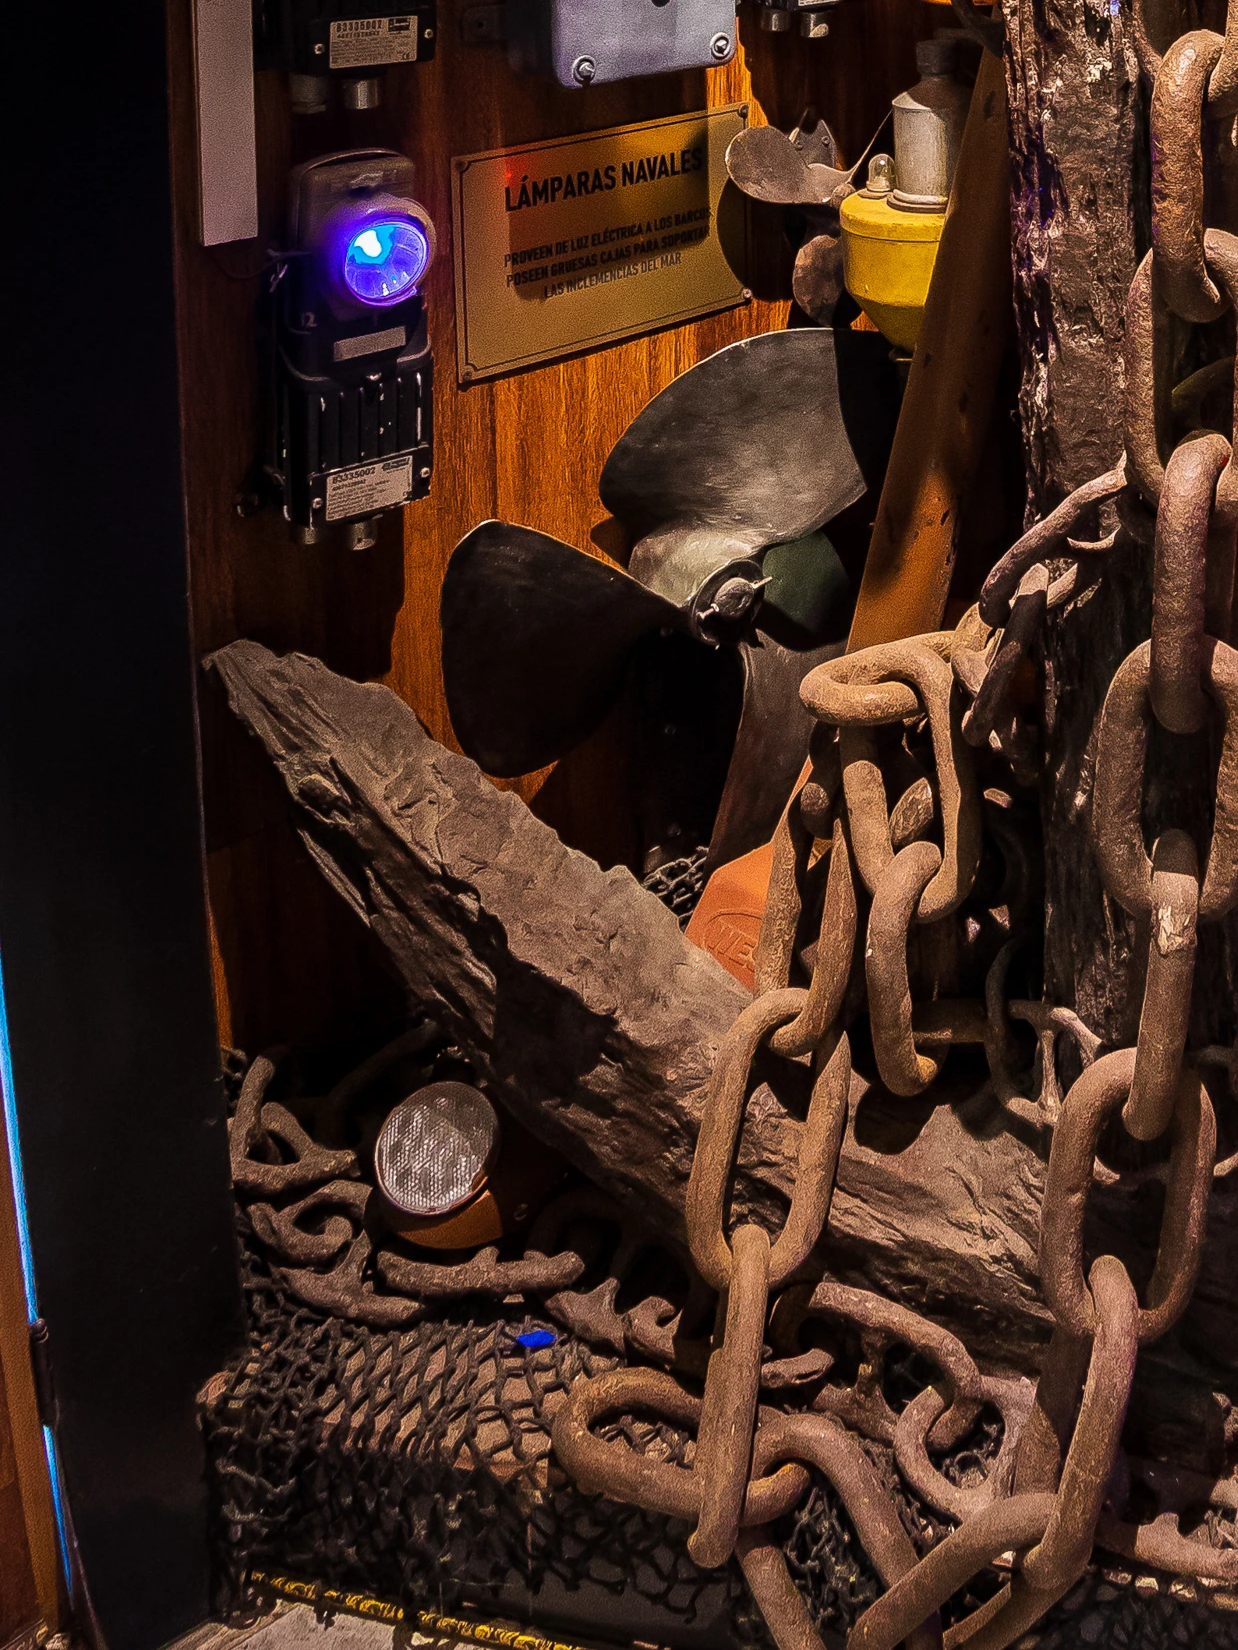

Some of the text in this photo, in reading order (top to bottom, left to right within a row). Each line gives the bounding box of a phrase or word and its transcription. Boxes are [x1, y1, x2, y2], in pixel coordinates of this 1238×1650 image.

[504, 149, 702, 212] LÁMPARAS NAVALES
[504, 246, 553, 268] PROVEEN
[556, 241, 569, 256] DE
[571, 237, 590, 252] LUZ
[591, 223, 643, 248] ELÉCTRICA
[645, 221, 653, 234] A
[654, 216, 673, 232] LOS
[506, 225, 711, 288] POSEEN GRUESAS CAJAS PARA SOPORTAR
[543, 252, 682, 299] LAS INCLEMENCIAS DEL MAR
